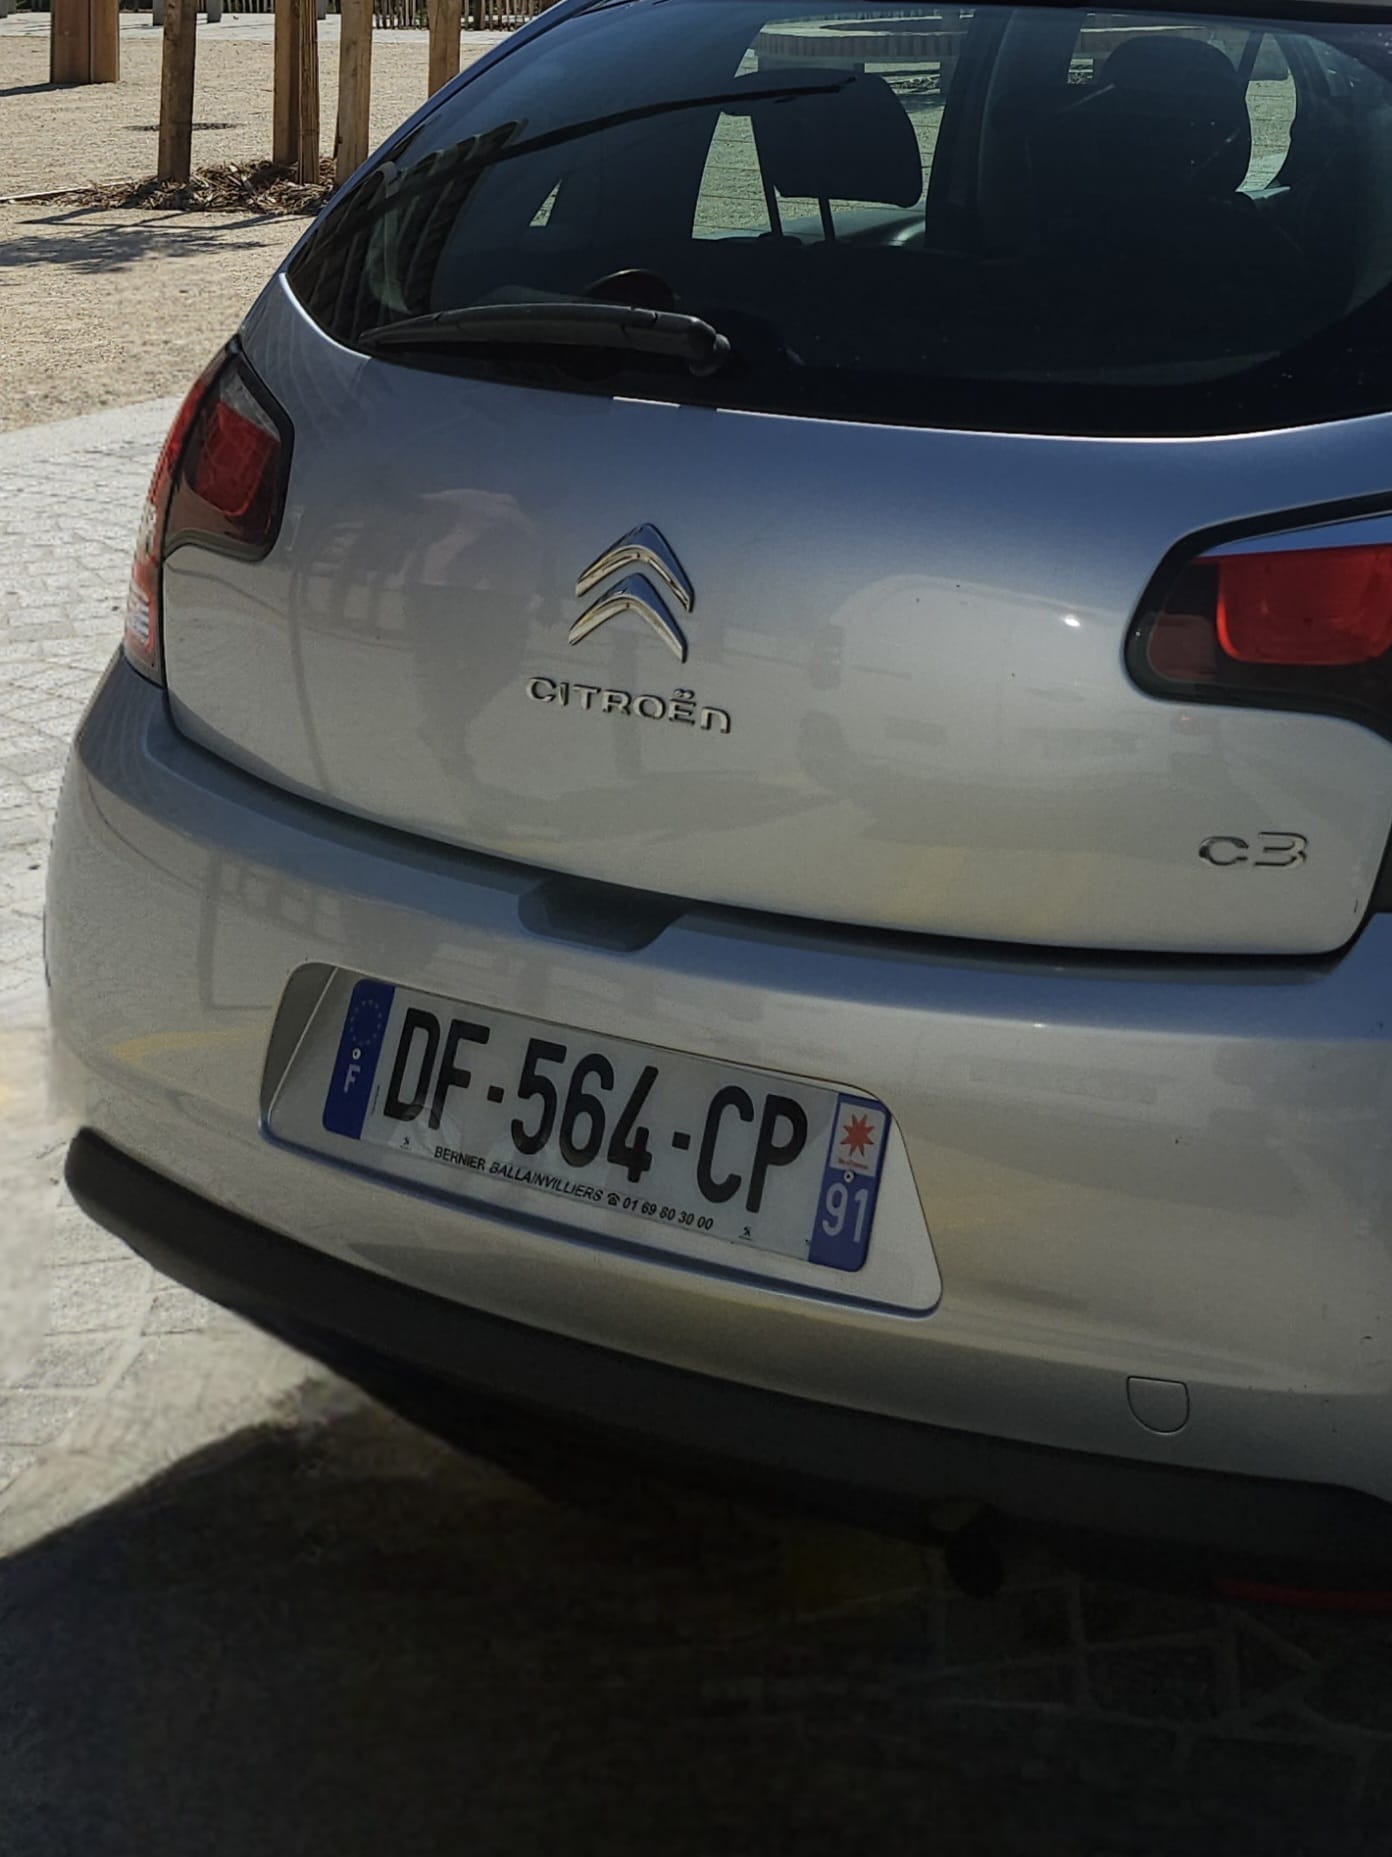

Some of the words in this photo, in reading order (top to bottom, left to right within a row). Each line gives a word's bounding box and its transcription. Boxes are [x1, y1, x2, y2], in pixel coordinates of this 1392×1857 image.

[526, 677, 732, 734] CITROËN
[1199, 831, 1308, 867] C3
[344, 1064, 361, 1094] F
[383, 1007, 808, 1214] DF-564-CP
[434, 1146, 486, 1171] BERNIER
[489, 1162, 602, 1202] BALLAINVILLIERS
[622, 1197, 638, 1211] 01
[641, 1201, 657, 1216] 69
[659, 1205, 676, 1221] 80
[678, 1210, 695, 1226] 30
[697, 1215, 713, 1231] 00
[822, 1182, 868, 1243] 91
